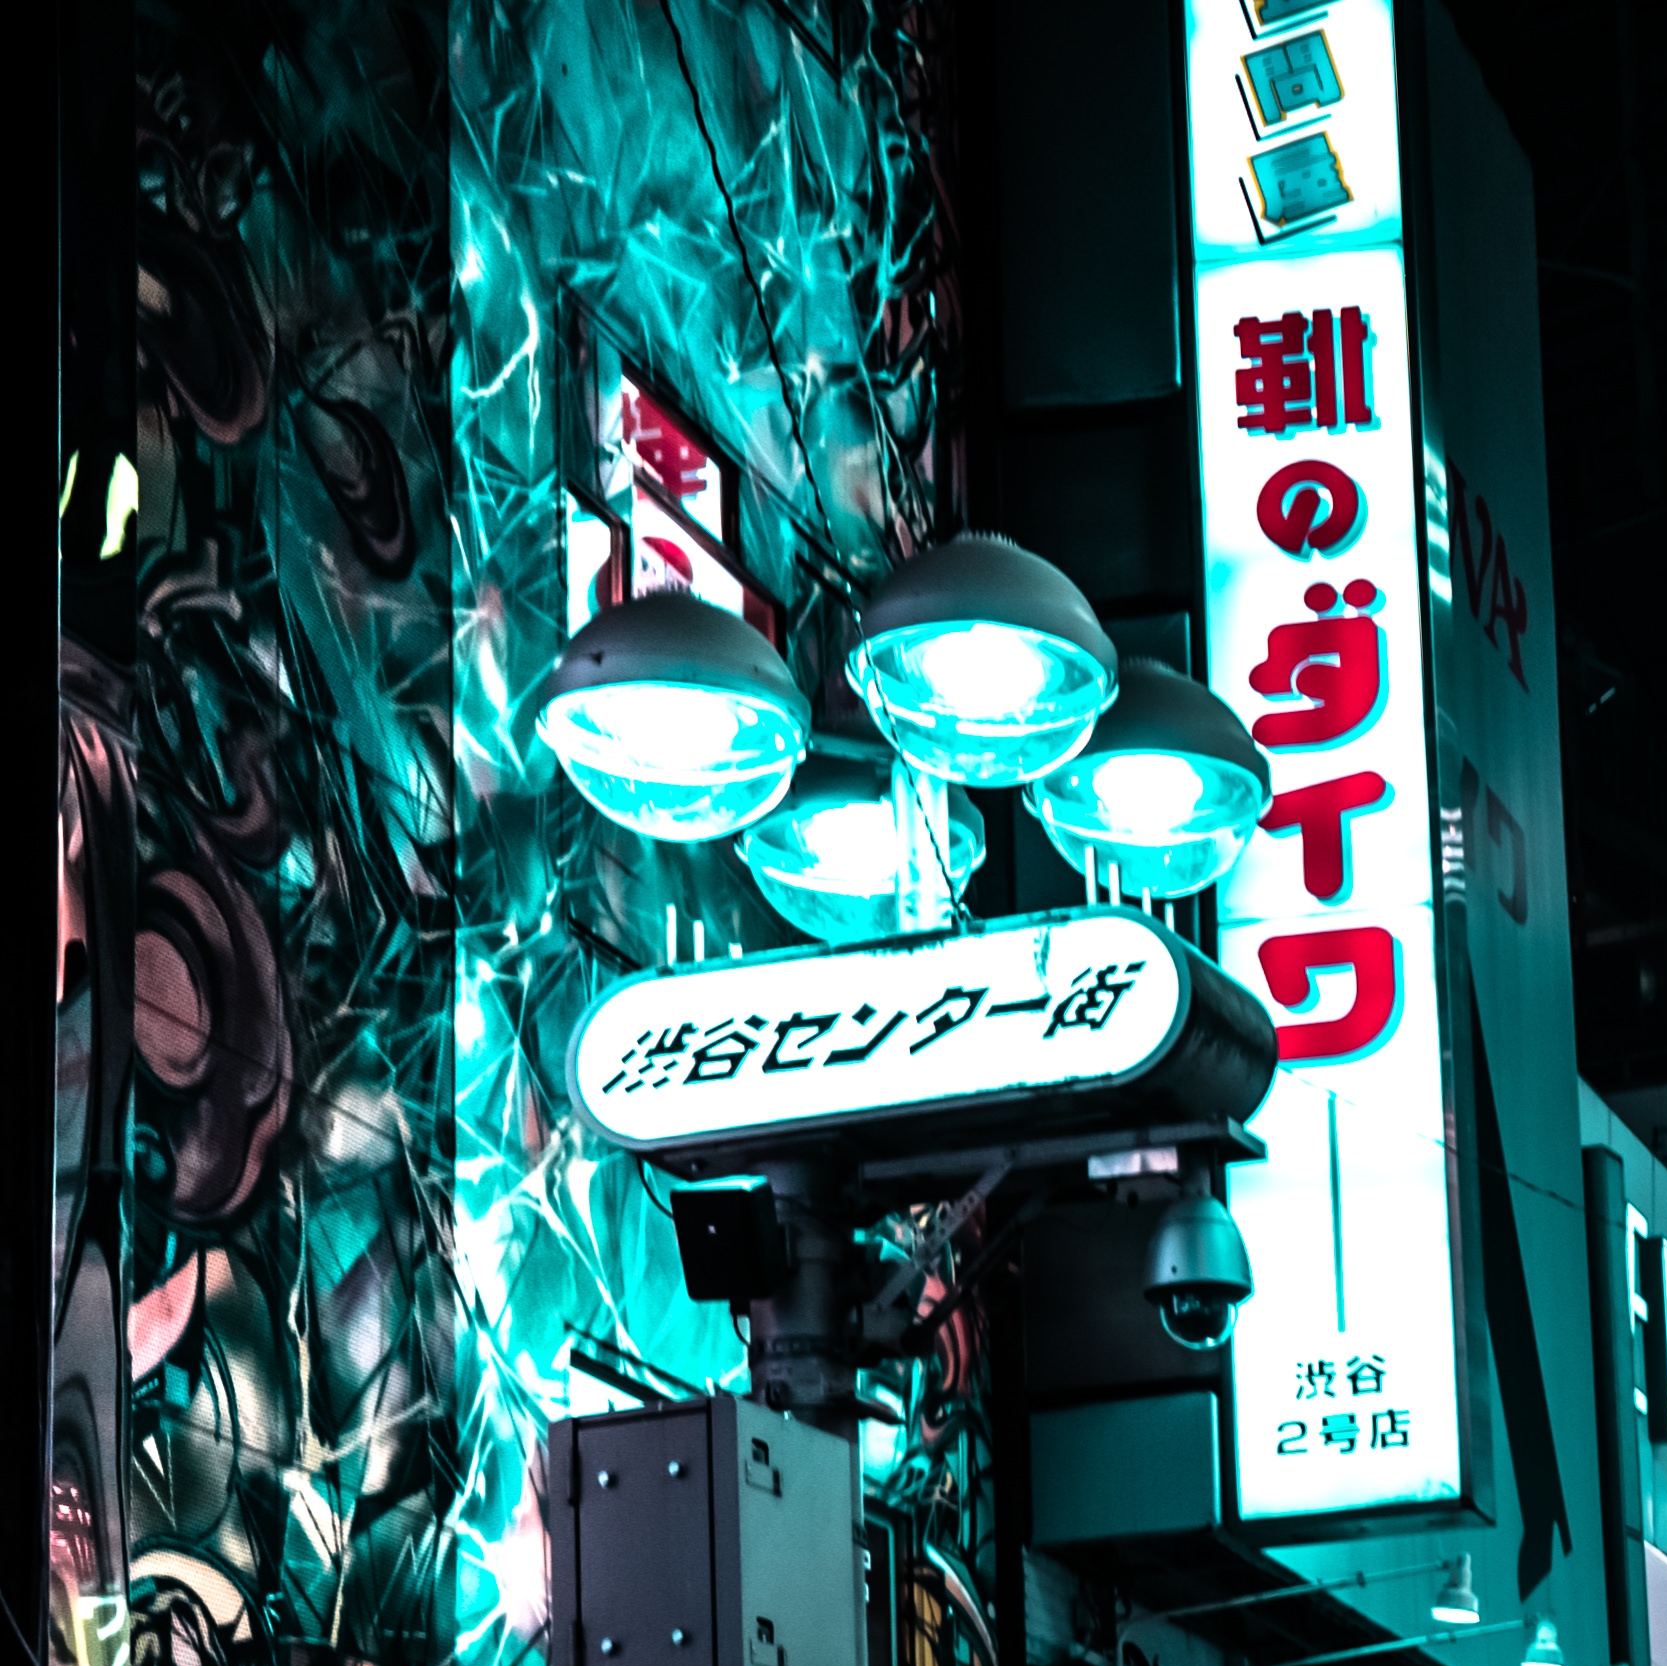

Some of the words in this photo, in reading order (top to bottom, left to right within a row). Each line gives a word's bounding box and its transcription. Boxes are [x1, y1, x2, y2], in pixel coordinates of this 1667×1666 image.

[603, 961, 1146, 1095] 渋谷センター街
[1295, 1355, 1388, 1402] 渋谷
[1277, 1411, 1411, 1456] 2号店
